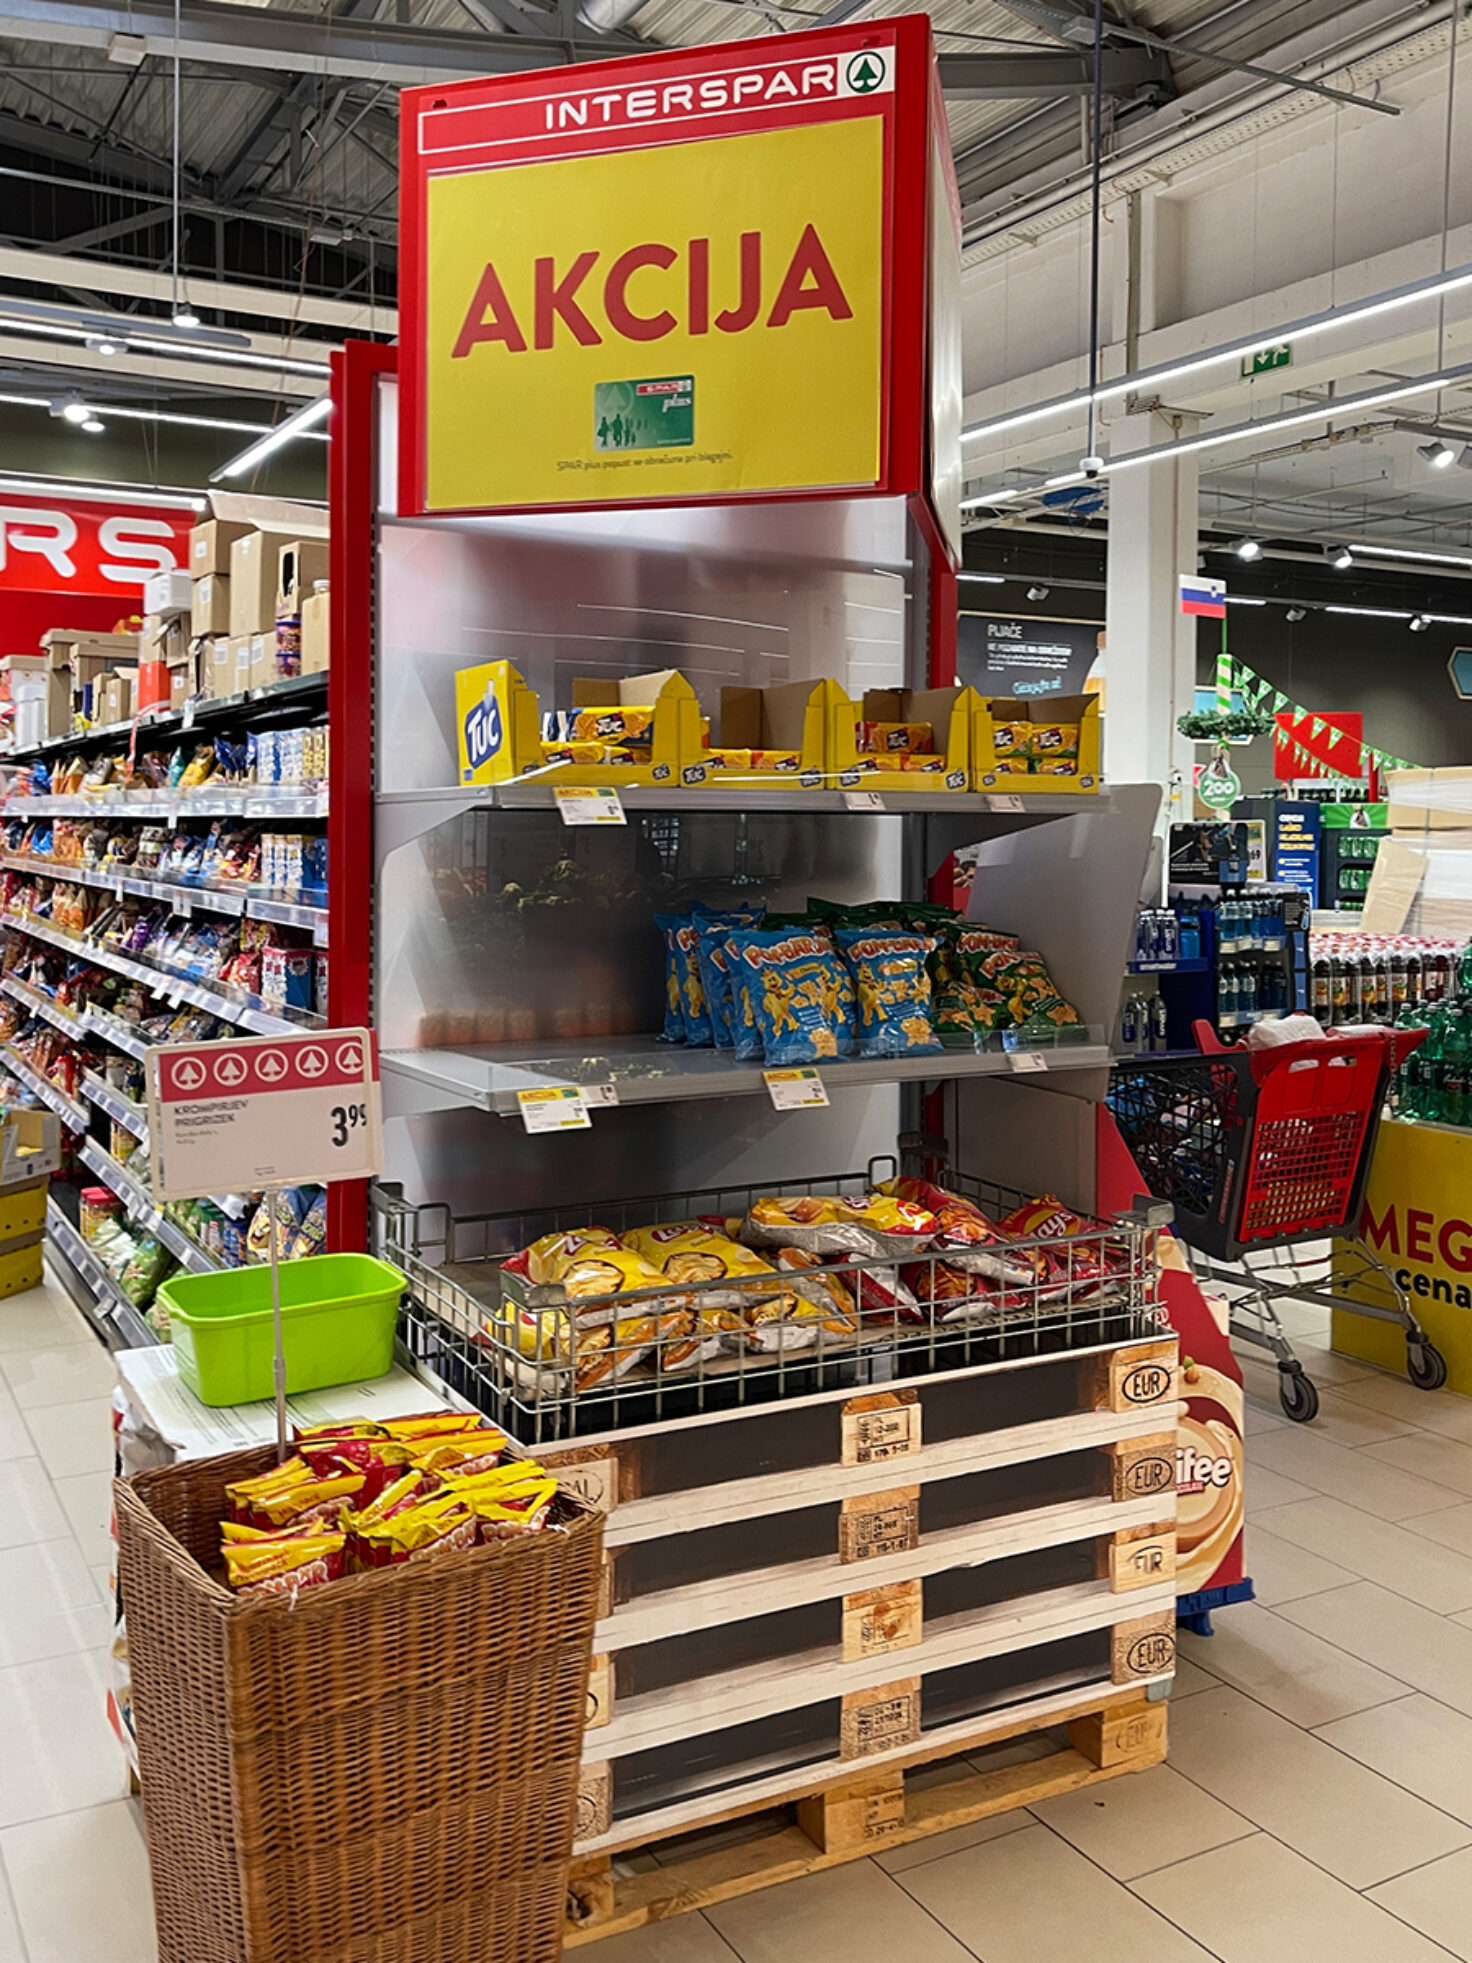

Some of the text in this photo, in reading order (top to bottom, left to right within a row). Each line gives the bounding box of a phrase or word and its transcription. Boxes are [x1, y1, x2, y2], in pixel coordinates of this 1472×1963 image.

[545, 62, 836, 130] INTERSPAR
[450, 223, 853, 359] AKCIJA
[662, 393, 692, 413] plus
[467, 708, 499, 762] TUC
[1203, 780, 1235, 796] 200
[1395, 1268, 1472, 1310] cena
[1133, 1371, 1160, 1397] EUR
[1135, 1463, 1162, 1489] EUR
[1176, 1446, 1231, 1488] ifee
[1137, 1638, 1167, 1668] EUR
